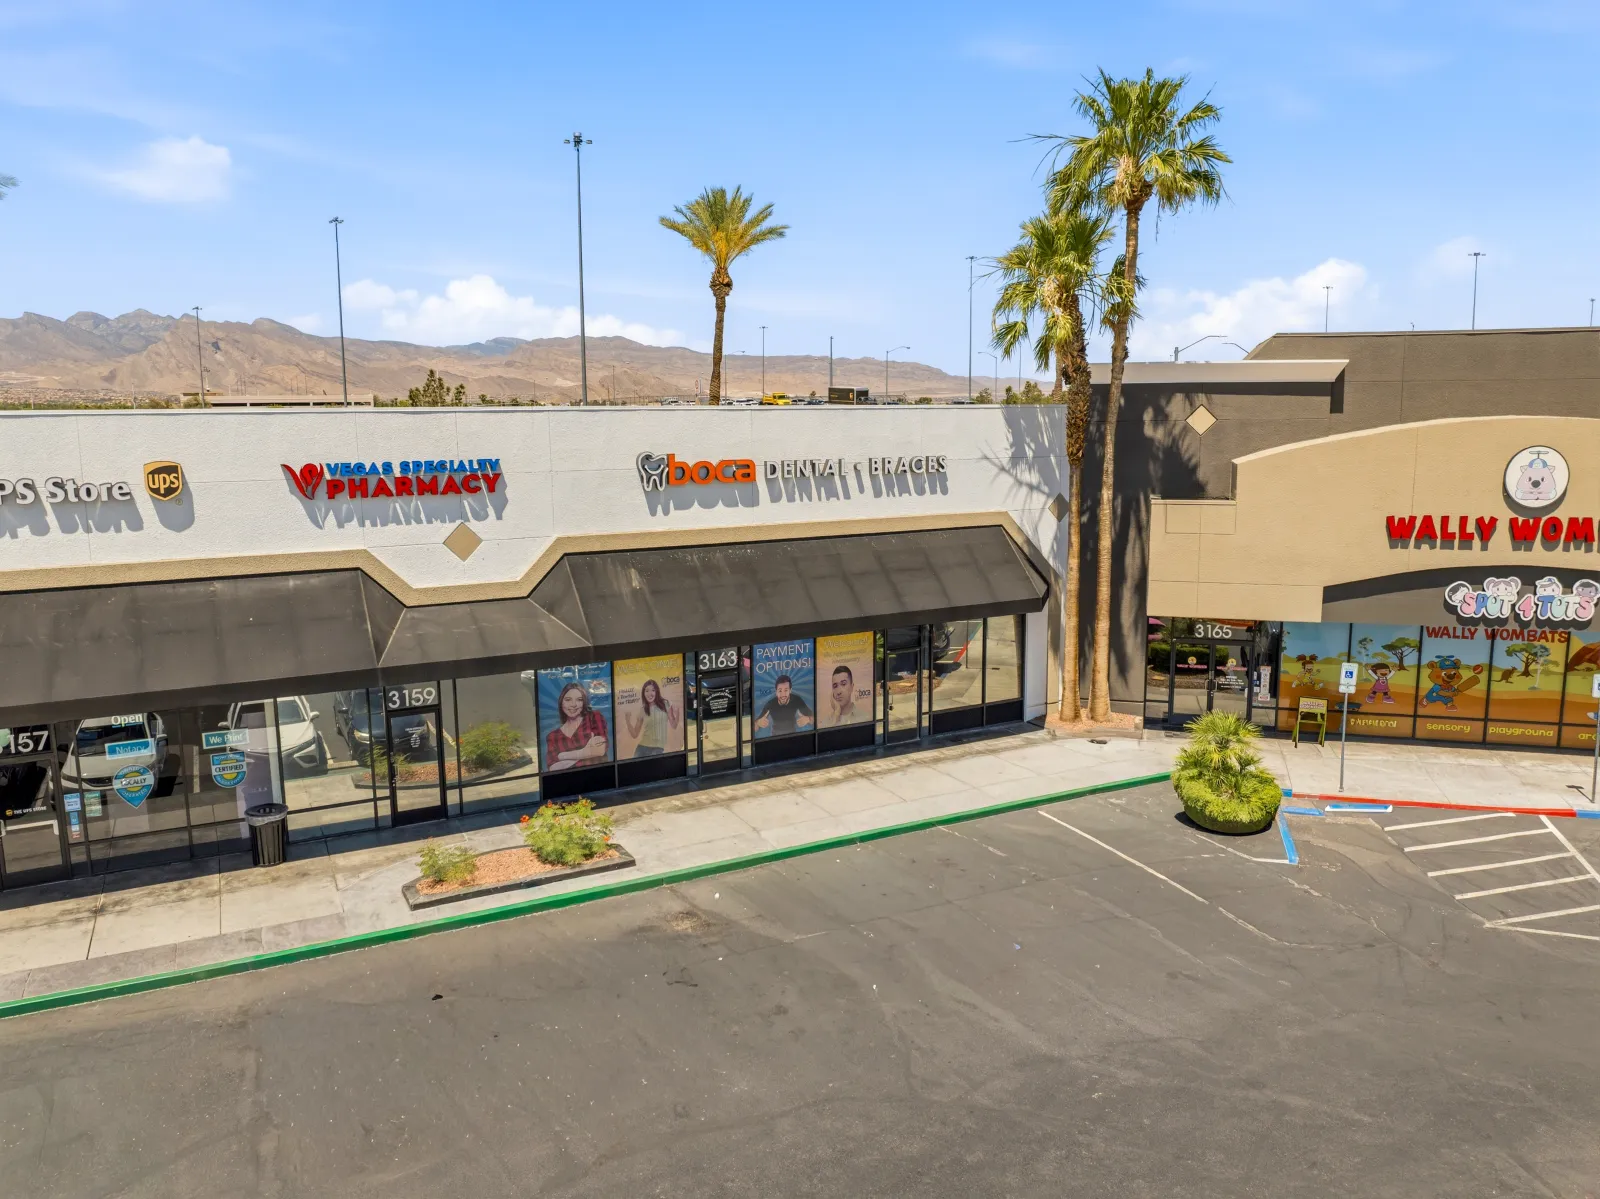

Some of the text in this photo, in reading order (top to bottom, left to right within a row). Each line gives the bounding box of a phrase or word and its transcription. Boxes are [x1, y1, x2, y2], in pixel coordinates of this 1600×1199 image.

[326, 458, 501, 476] VEGAS SPECIALTY
[667, 453, 948, 486] boca DENTAL BRACES
[45, 477, 131, 503] Store
[147, 473, 179, 494] ups
[326, 473, 502, 499] PHARMACY
[1386, 515, 1600, 543] WALLY WOM
[1460, 592, 1595, 620] SPOT 4 TOTS
[1195, 624, 1232, 639] 3165
[1426, 626, 1569, 644] WALLY WOMBATS
[700, 650, 737, 670] 3163
[756, 643, 811, 659] PAYMENT
[756, 657, 811, 674] OPTIONS!
[388, 687, 436, 708] 3159
[111, 713, 143, 728] Open
[1426, 722, 1471, 733] sensory
[209, 732, 243, 744] We Print
[1488, 725, 1553, 737] playground
[0, 731, 48, 753] 157
[115, 745, 145, 755] Notary
[215, 764, 244, 773] CERTIFIED
